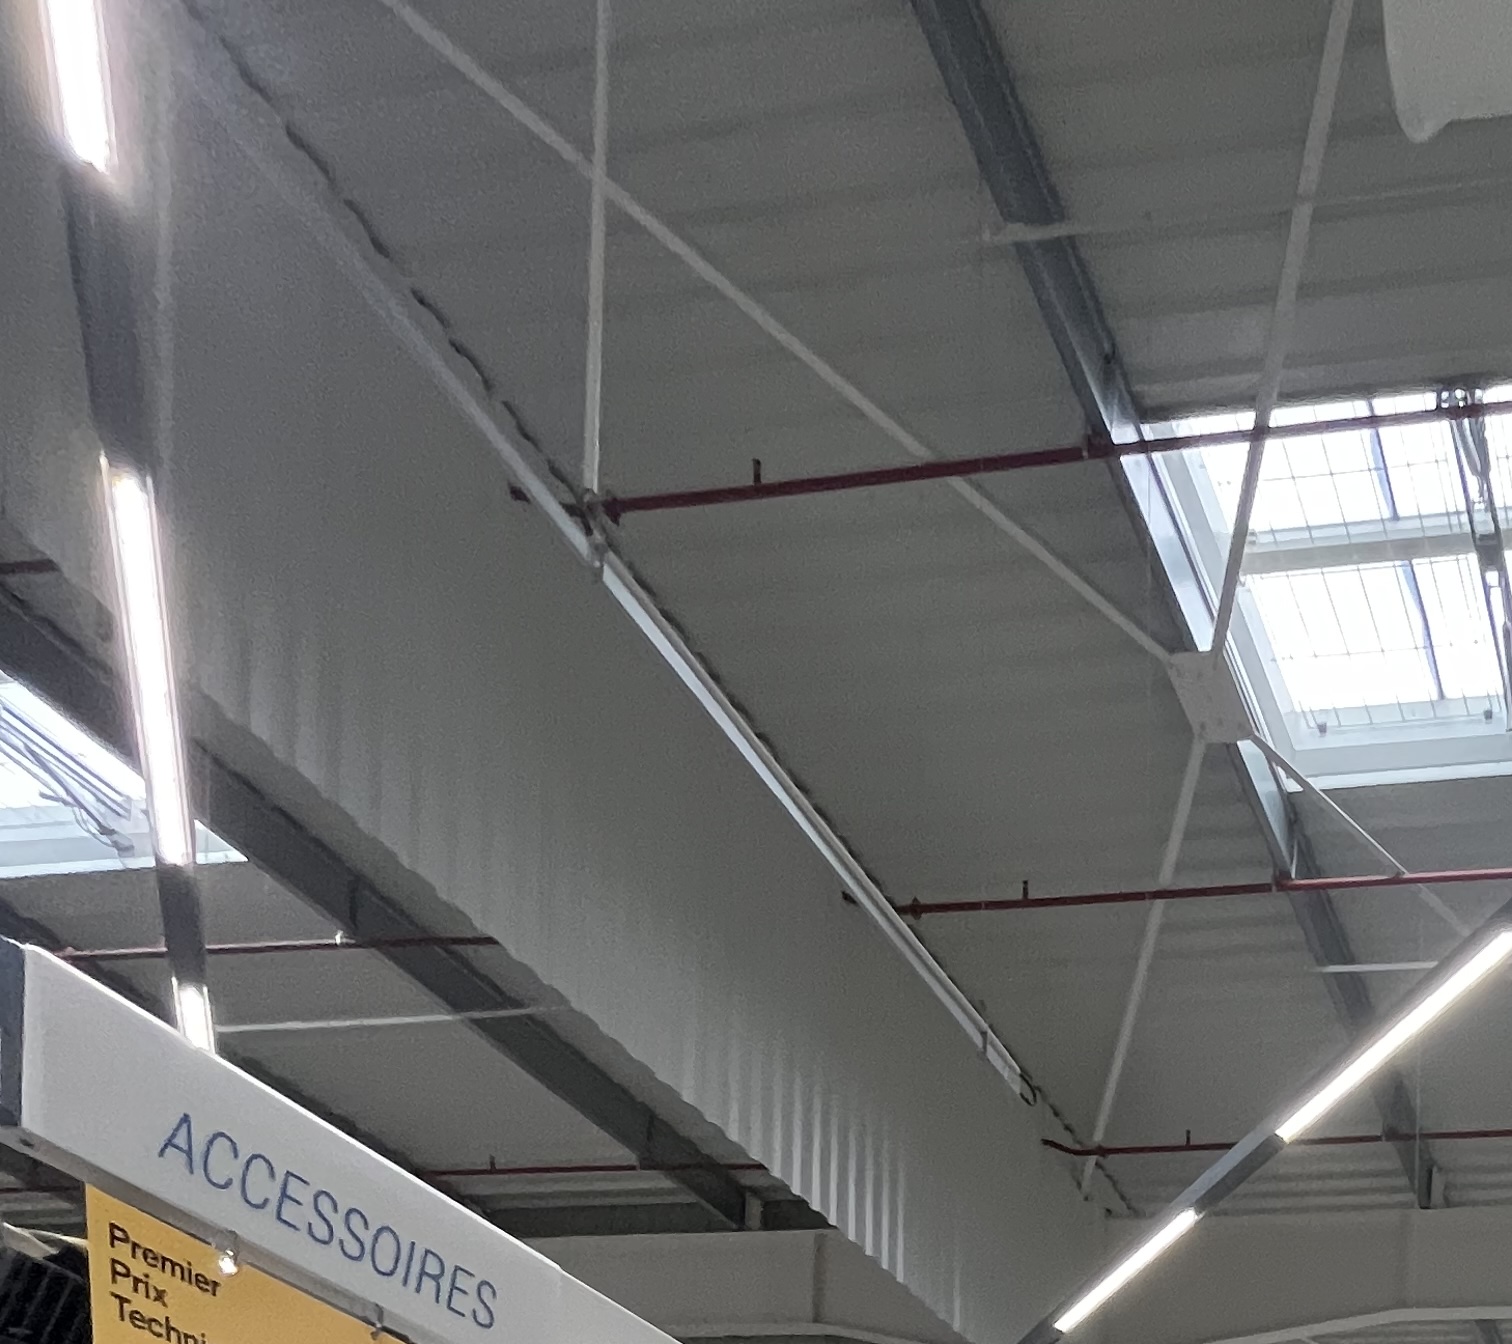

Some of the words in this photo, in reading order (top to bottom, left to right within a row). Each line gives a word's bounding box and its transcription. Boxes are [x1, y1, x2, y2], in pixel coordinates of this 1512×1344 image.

[109, 1221, 222, 1297] Premier
[158, 1113, 498, 1330] ACCESSOIRES
[110, 1258, 169, 1308] Prix
